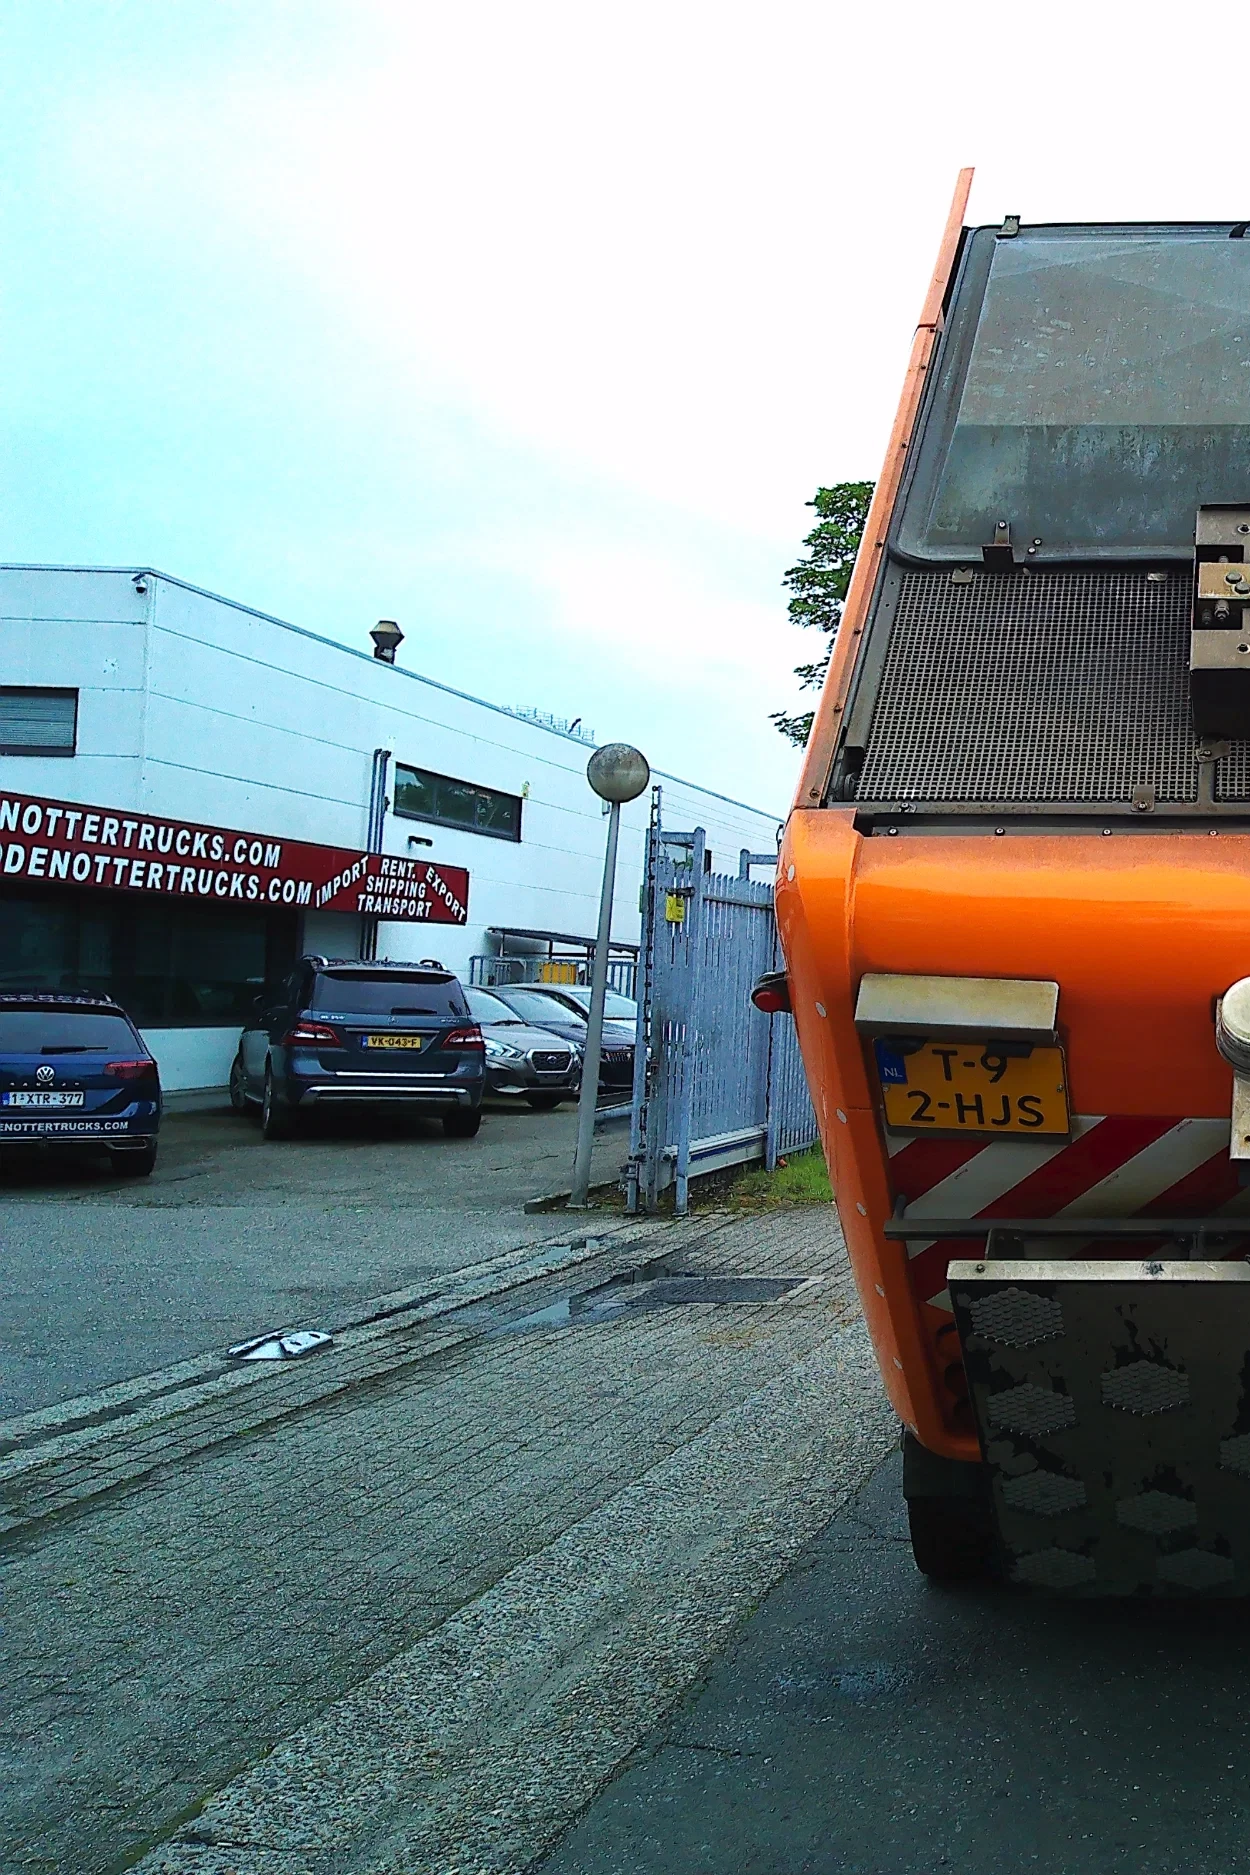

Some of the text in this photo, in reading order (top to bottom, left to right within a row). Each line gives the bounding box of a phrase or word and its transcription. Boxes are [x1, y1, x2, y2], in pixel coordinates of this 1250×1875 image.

[0, 800, 281, 868] NOTTERTRUCKS.COM
[0, 843, 312, 904] DENOTTERTRUCKS.COM
[316, 855, 369, 908] IMPORT
[366, 875, 427, 899] SHIPPING
[357, 894, 432, 918] TRANSPORT
[425, 866, 466, 922] EXPORT
[883, 1067, 903, 1078] NL
[931, 1049, 1008, 1083] T-9
[907, 1090, 1045, 1127] 2-HJS
